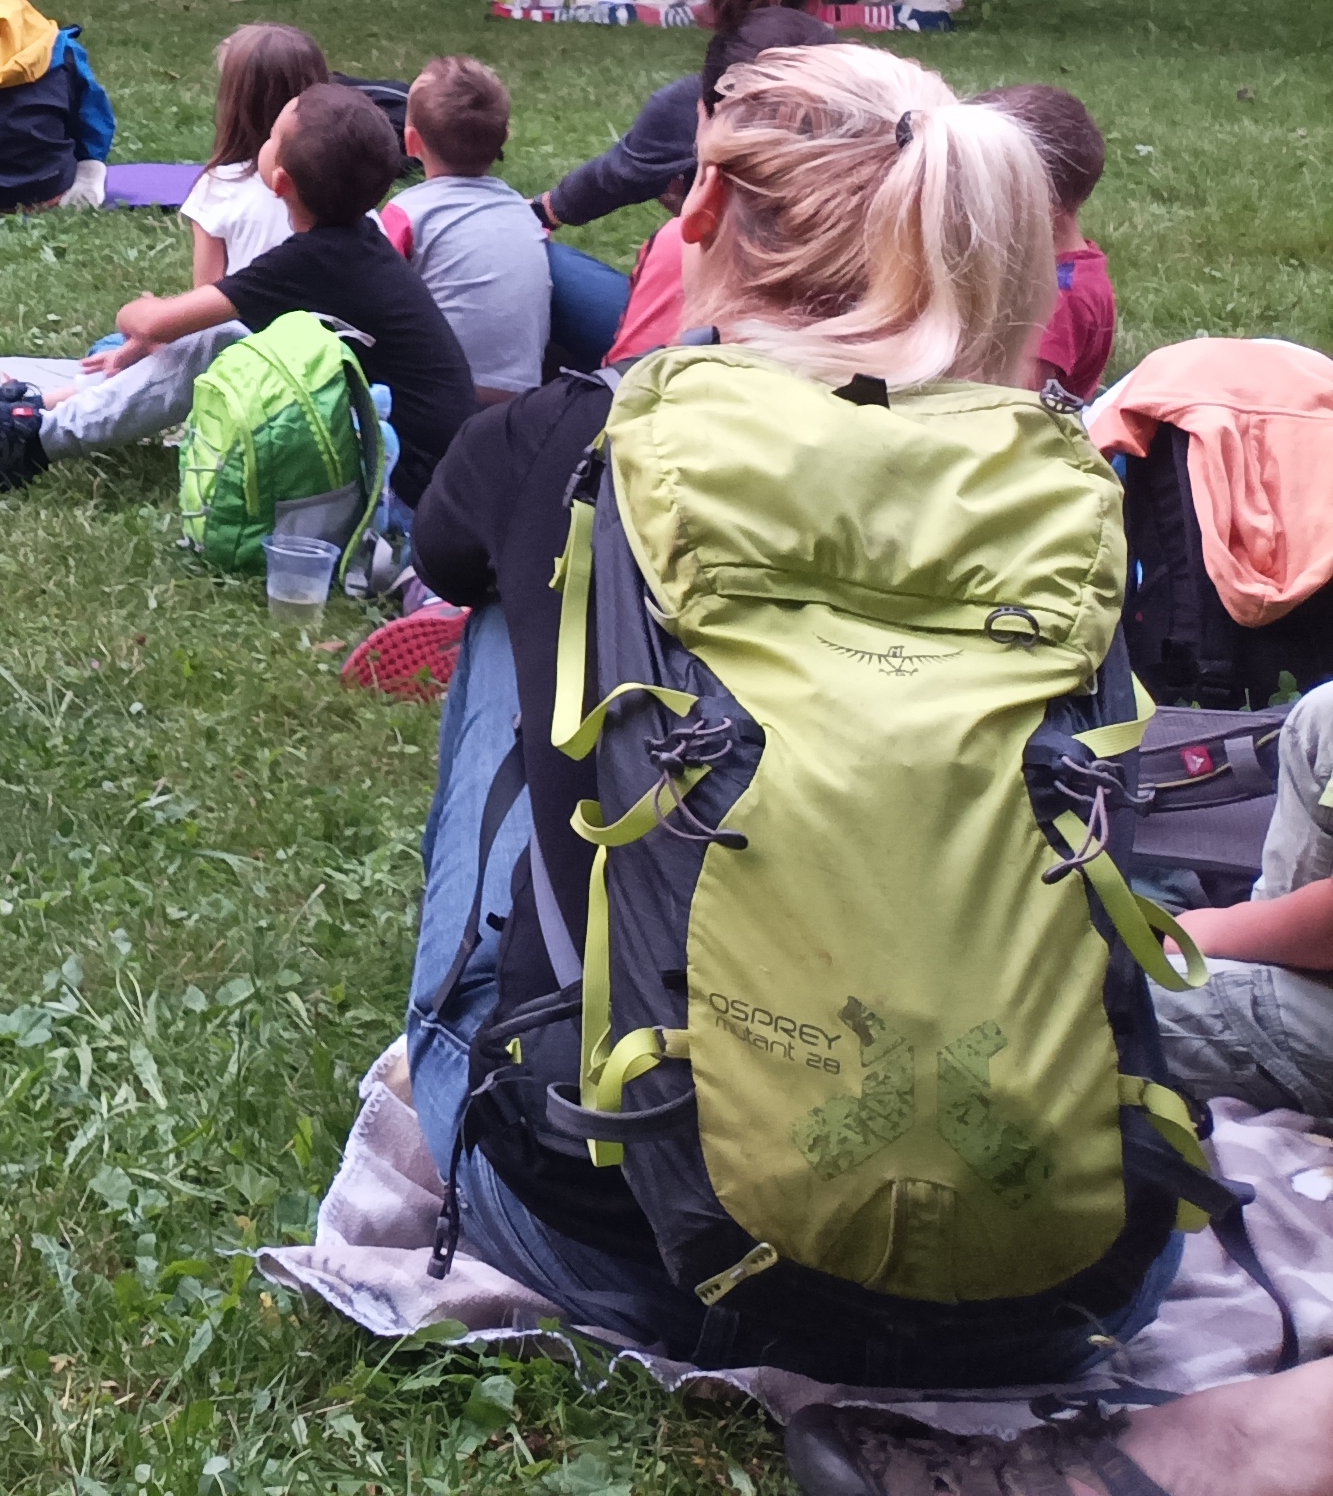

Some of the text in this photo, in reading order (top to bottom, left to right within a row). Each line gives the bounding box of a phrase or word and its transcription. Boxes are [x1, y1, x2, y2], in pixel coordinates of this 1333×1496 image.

[709, 992, 842, 1051] OSPREY
[716, 1015, 841, 1075] mutant 28
